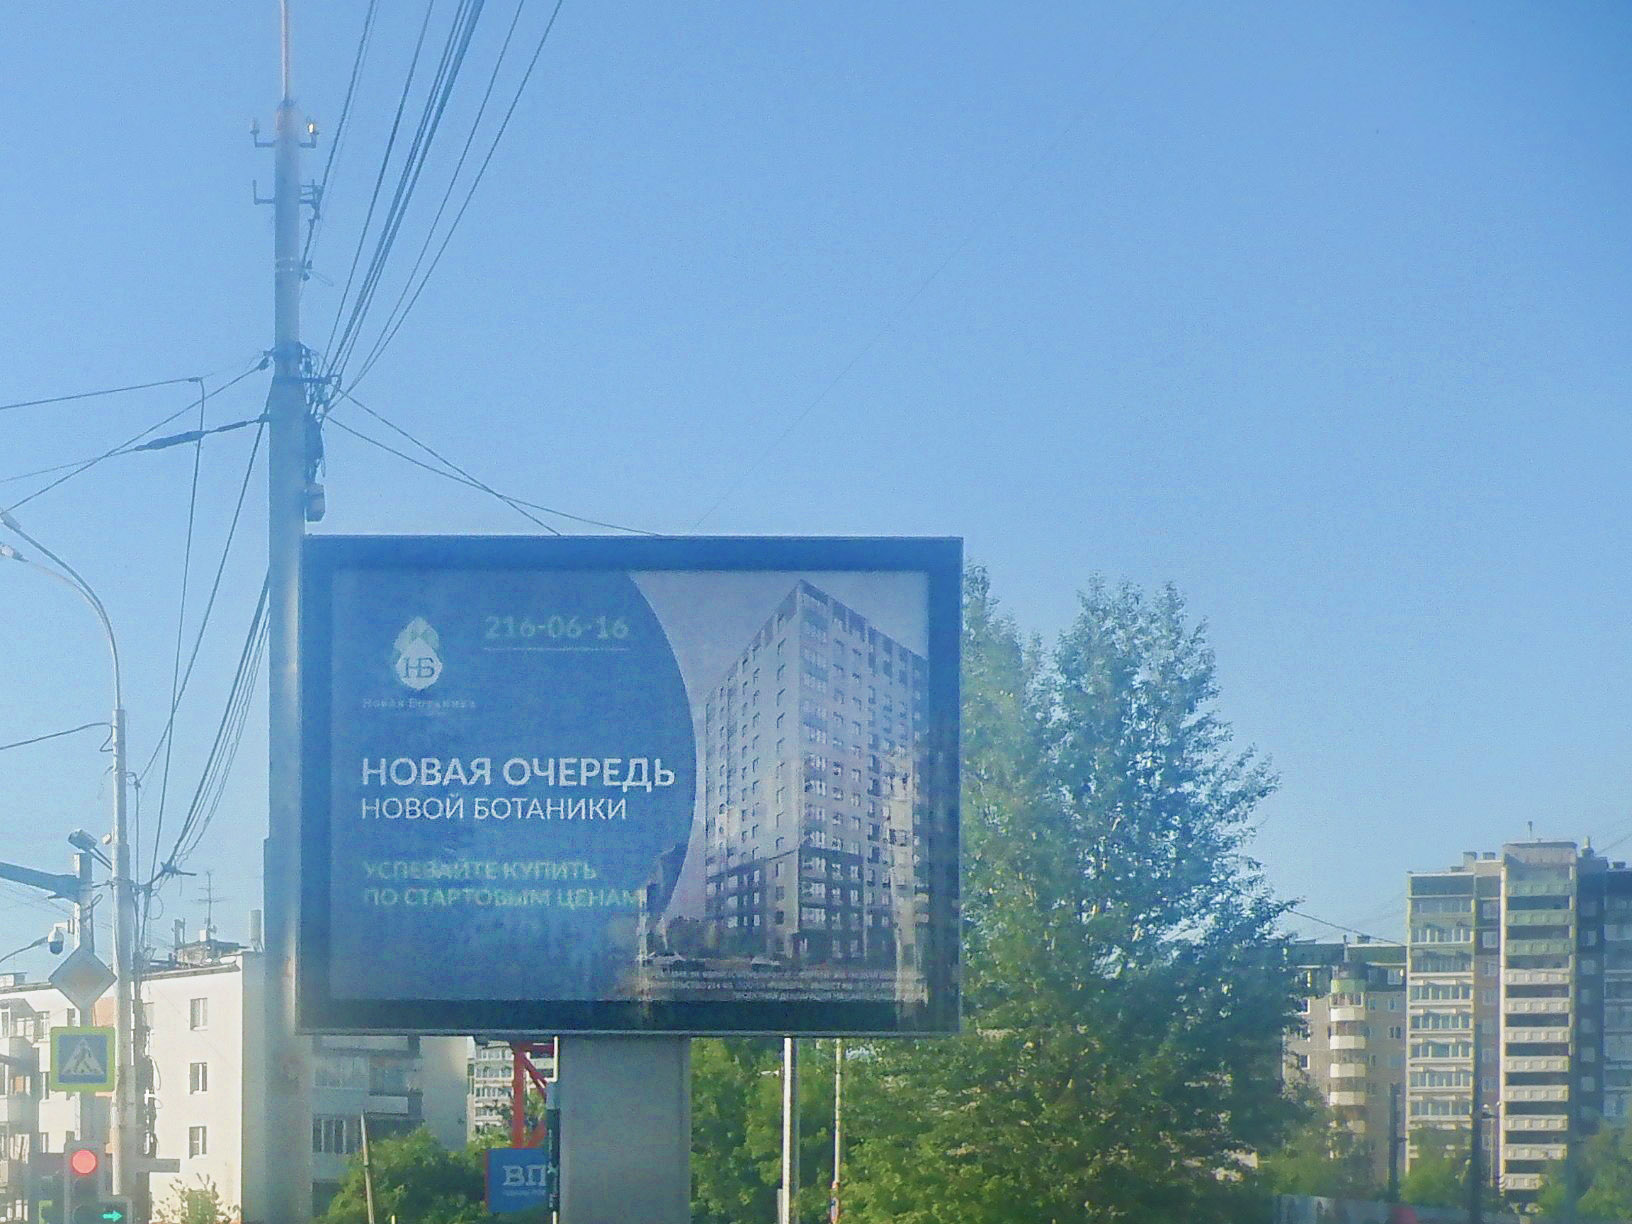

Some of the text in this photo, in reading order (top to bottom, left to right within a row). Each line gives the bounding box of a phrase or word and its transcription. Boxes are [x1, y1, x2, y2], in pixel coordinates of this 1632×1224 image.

[484, 614, 630, 640] 216-06-16
[361, 757, 676, 793] НОВАЯ ОЧЕРЕДЬ
[361, 793, 627, 820] НОВОЙ БОТАНИКИ
[504, 861, 597, 880] КУПИТЬ
[365, 888, 399, 906] ПО
